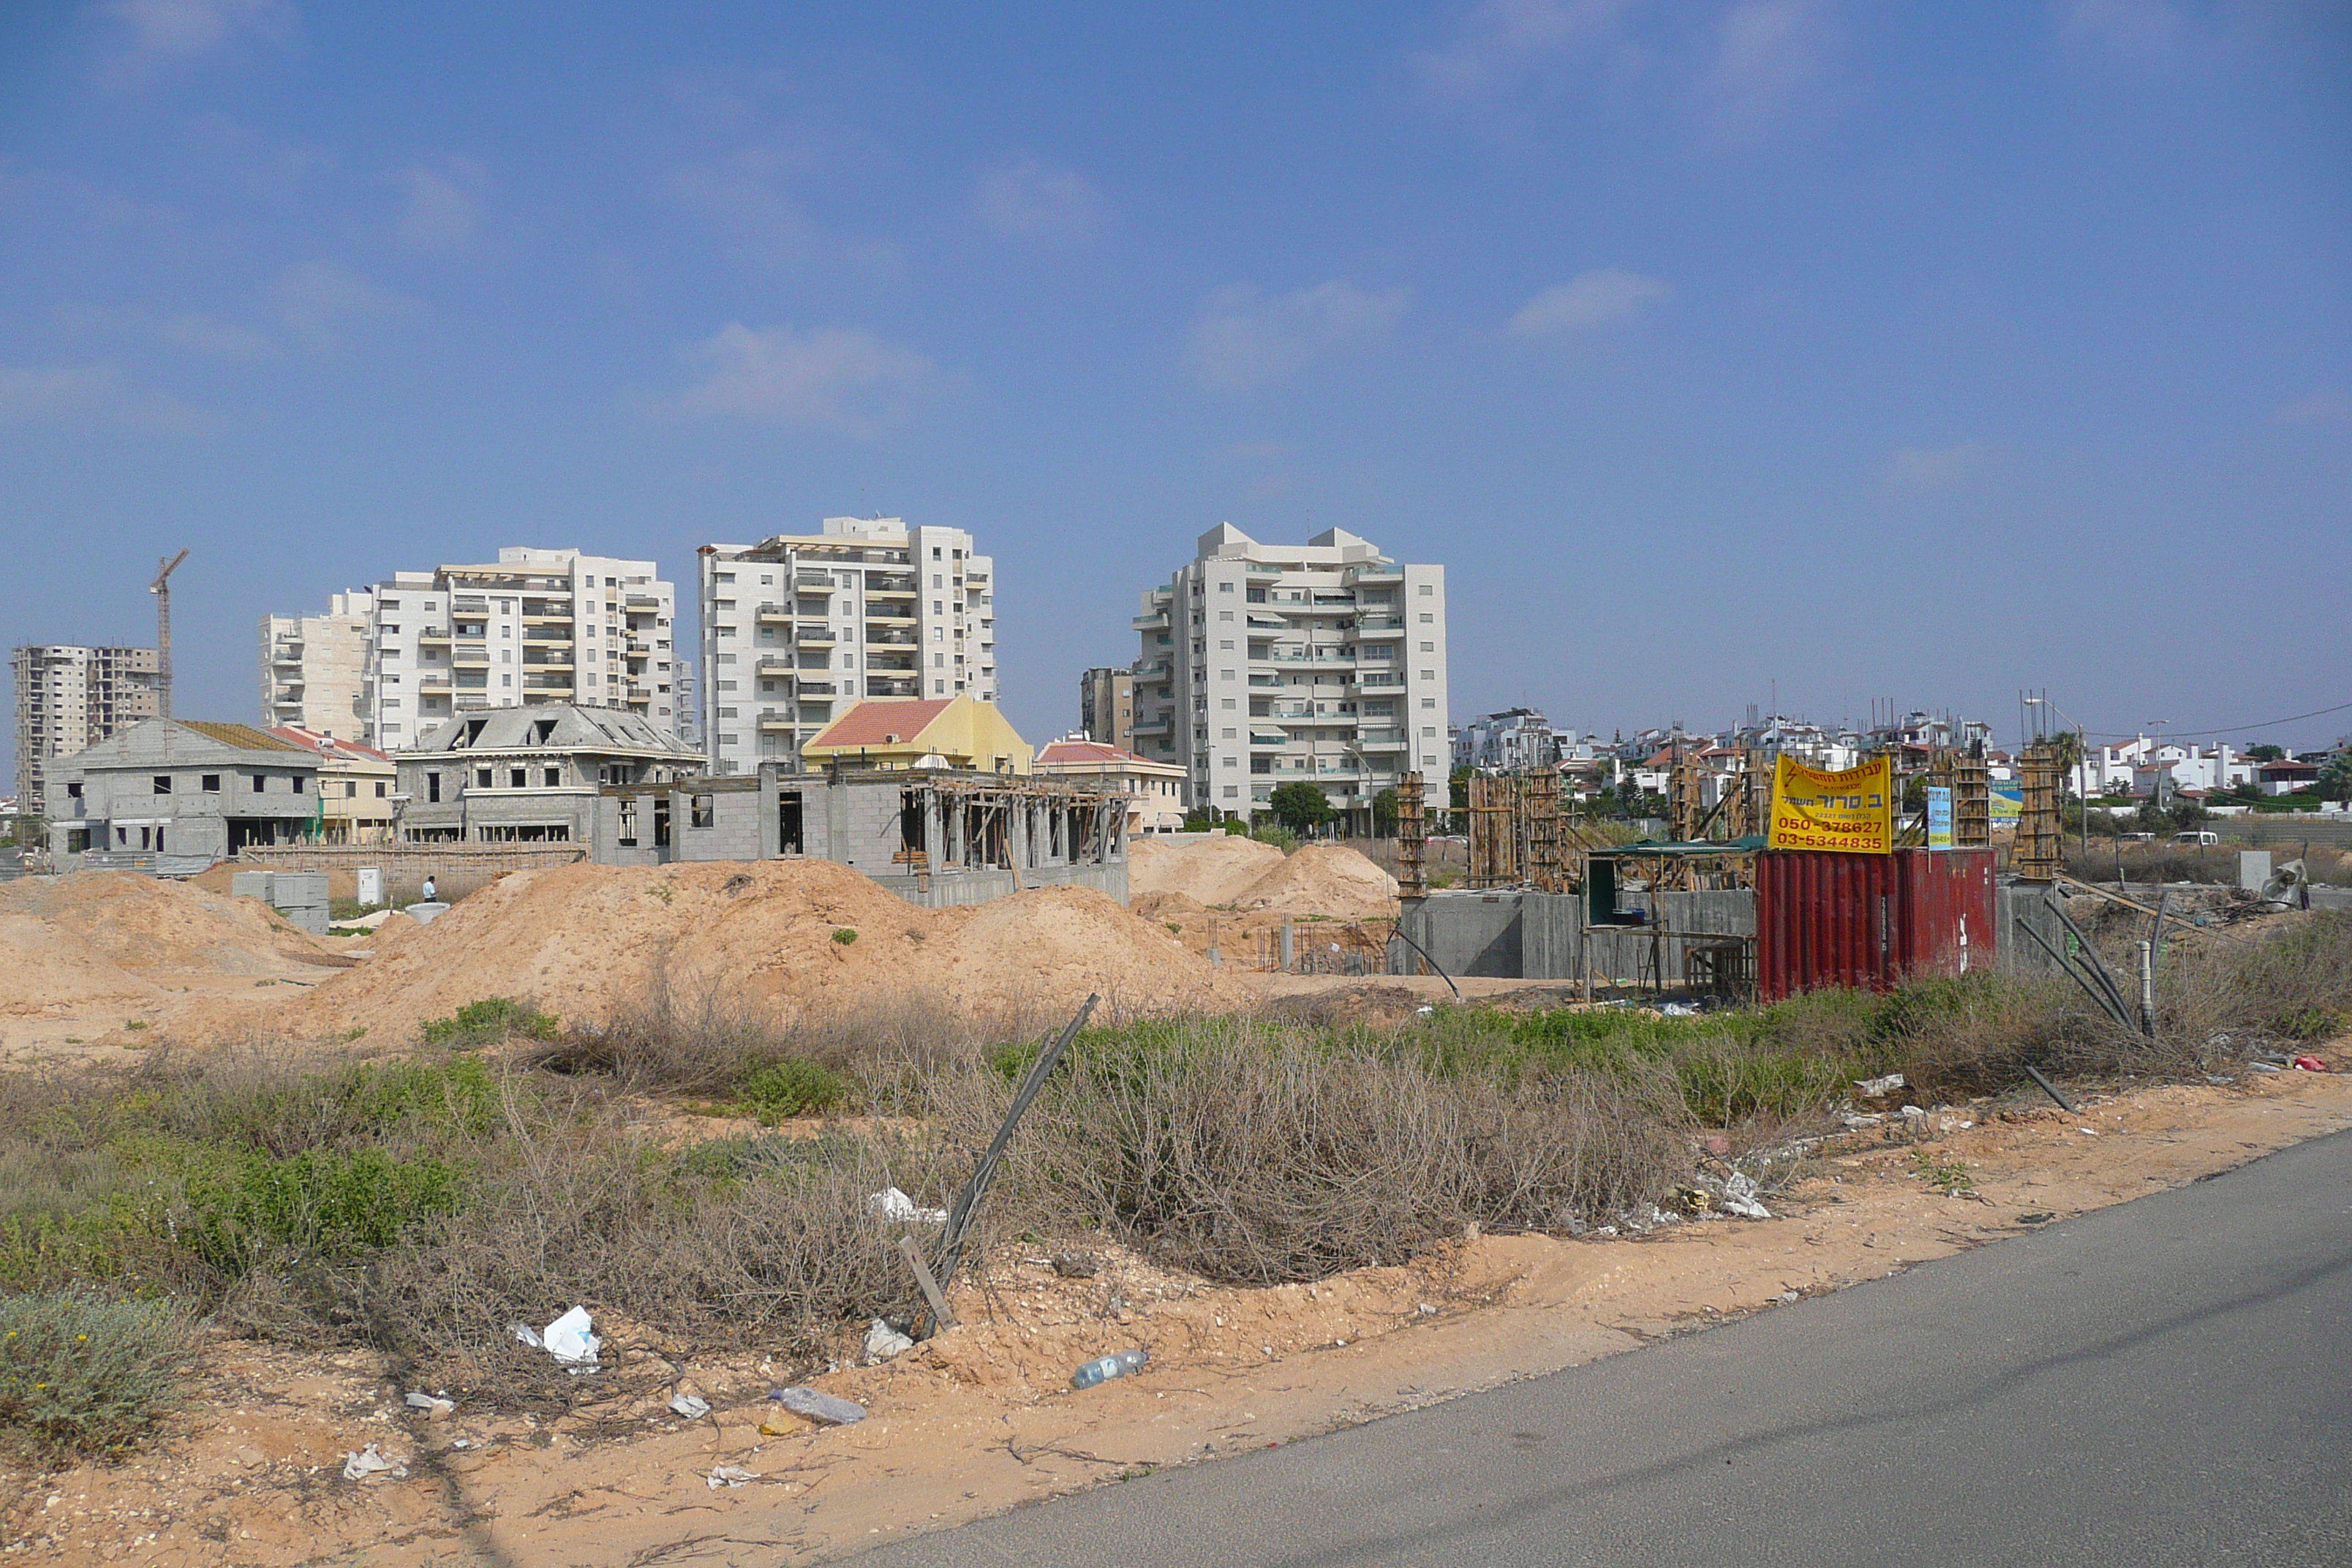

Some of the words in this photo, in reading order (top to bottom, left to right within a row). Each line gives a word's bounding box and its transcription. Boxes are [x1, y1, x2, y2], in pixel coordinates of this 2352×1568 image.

[1837, 763, 1882, 782] עבודות
[1782, 795, 1814, 807] חשמל
[1777, 833, 1882, 849] 03-5344835
